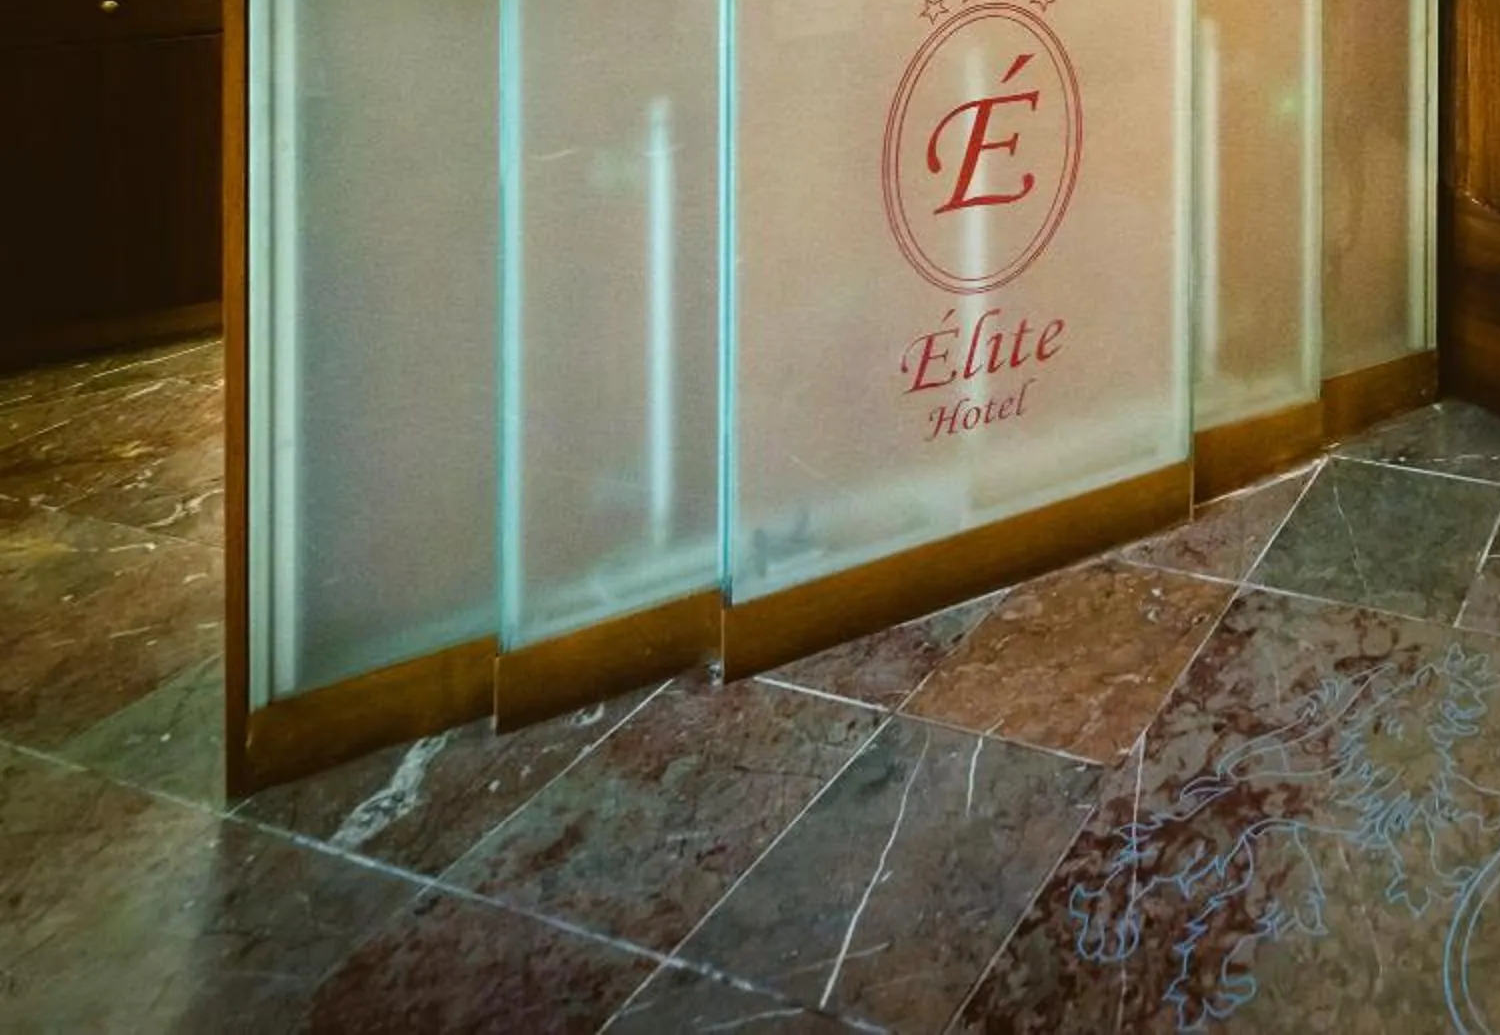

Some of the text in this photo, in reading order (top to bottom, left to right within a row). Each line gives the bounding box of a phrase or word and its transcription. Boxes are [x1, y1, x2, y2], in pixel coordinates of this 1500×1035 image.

[927, 53, 1040, 215] É
[900, 308, 1065, 394] Élite
[924, 378, 1037, 442] Hotel
